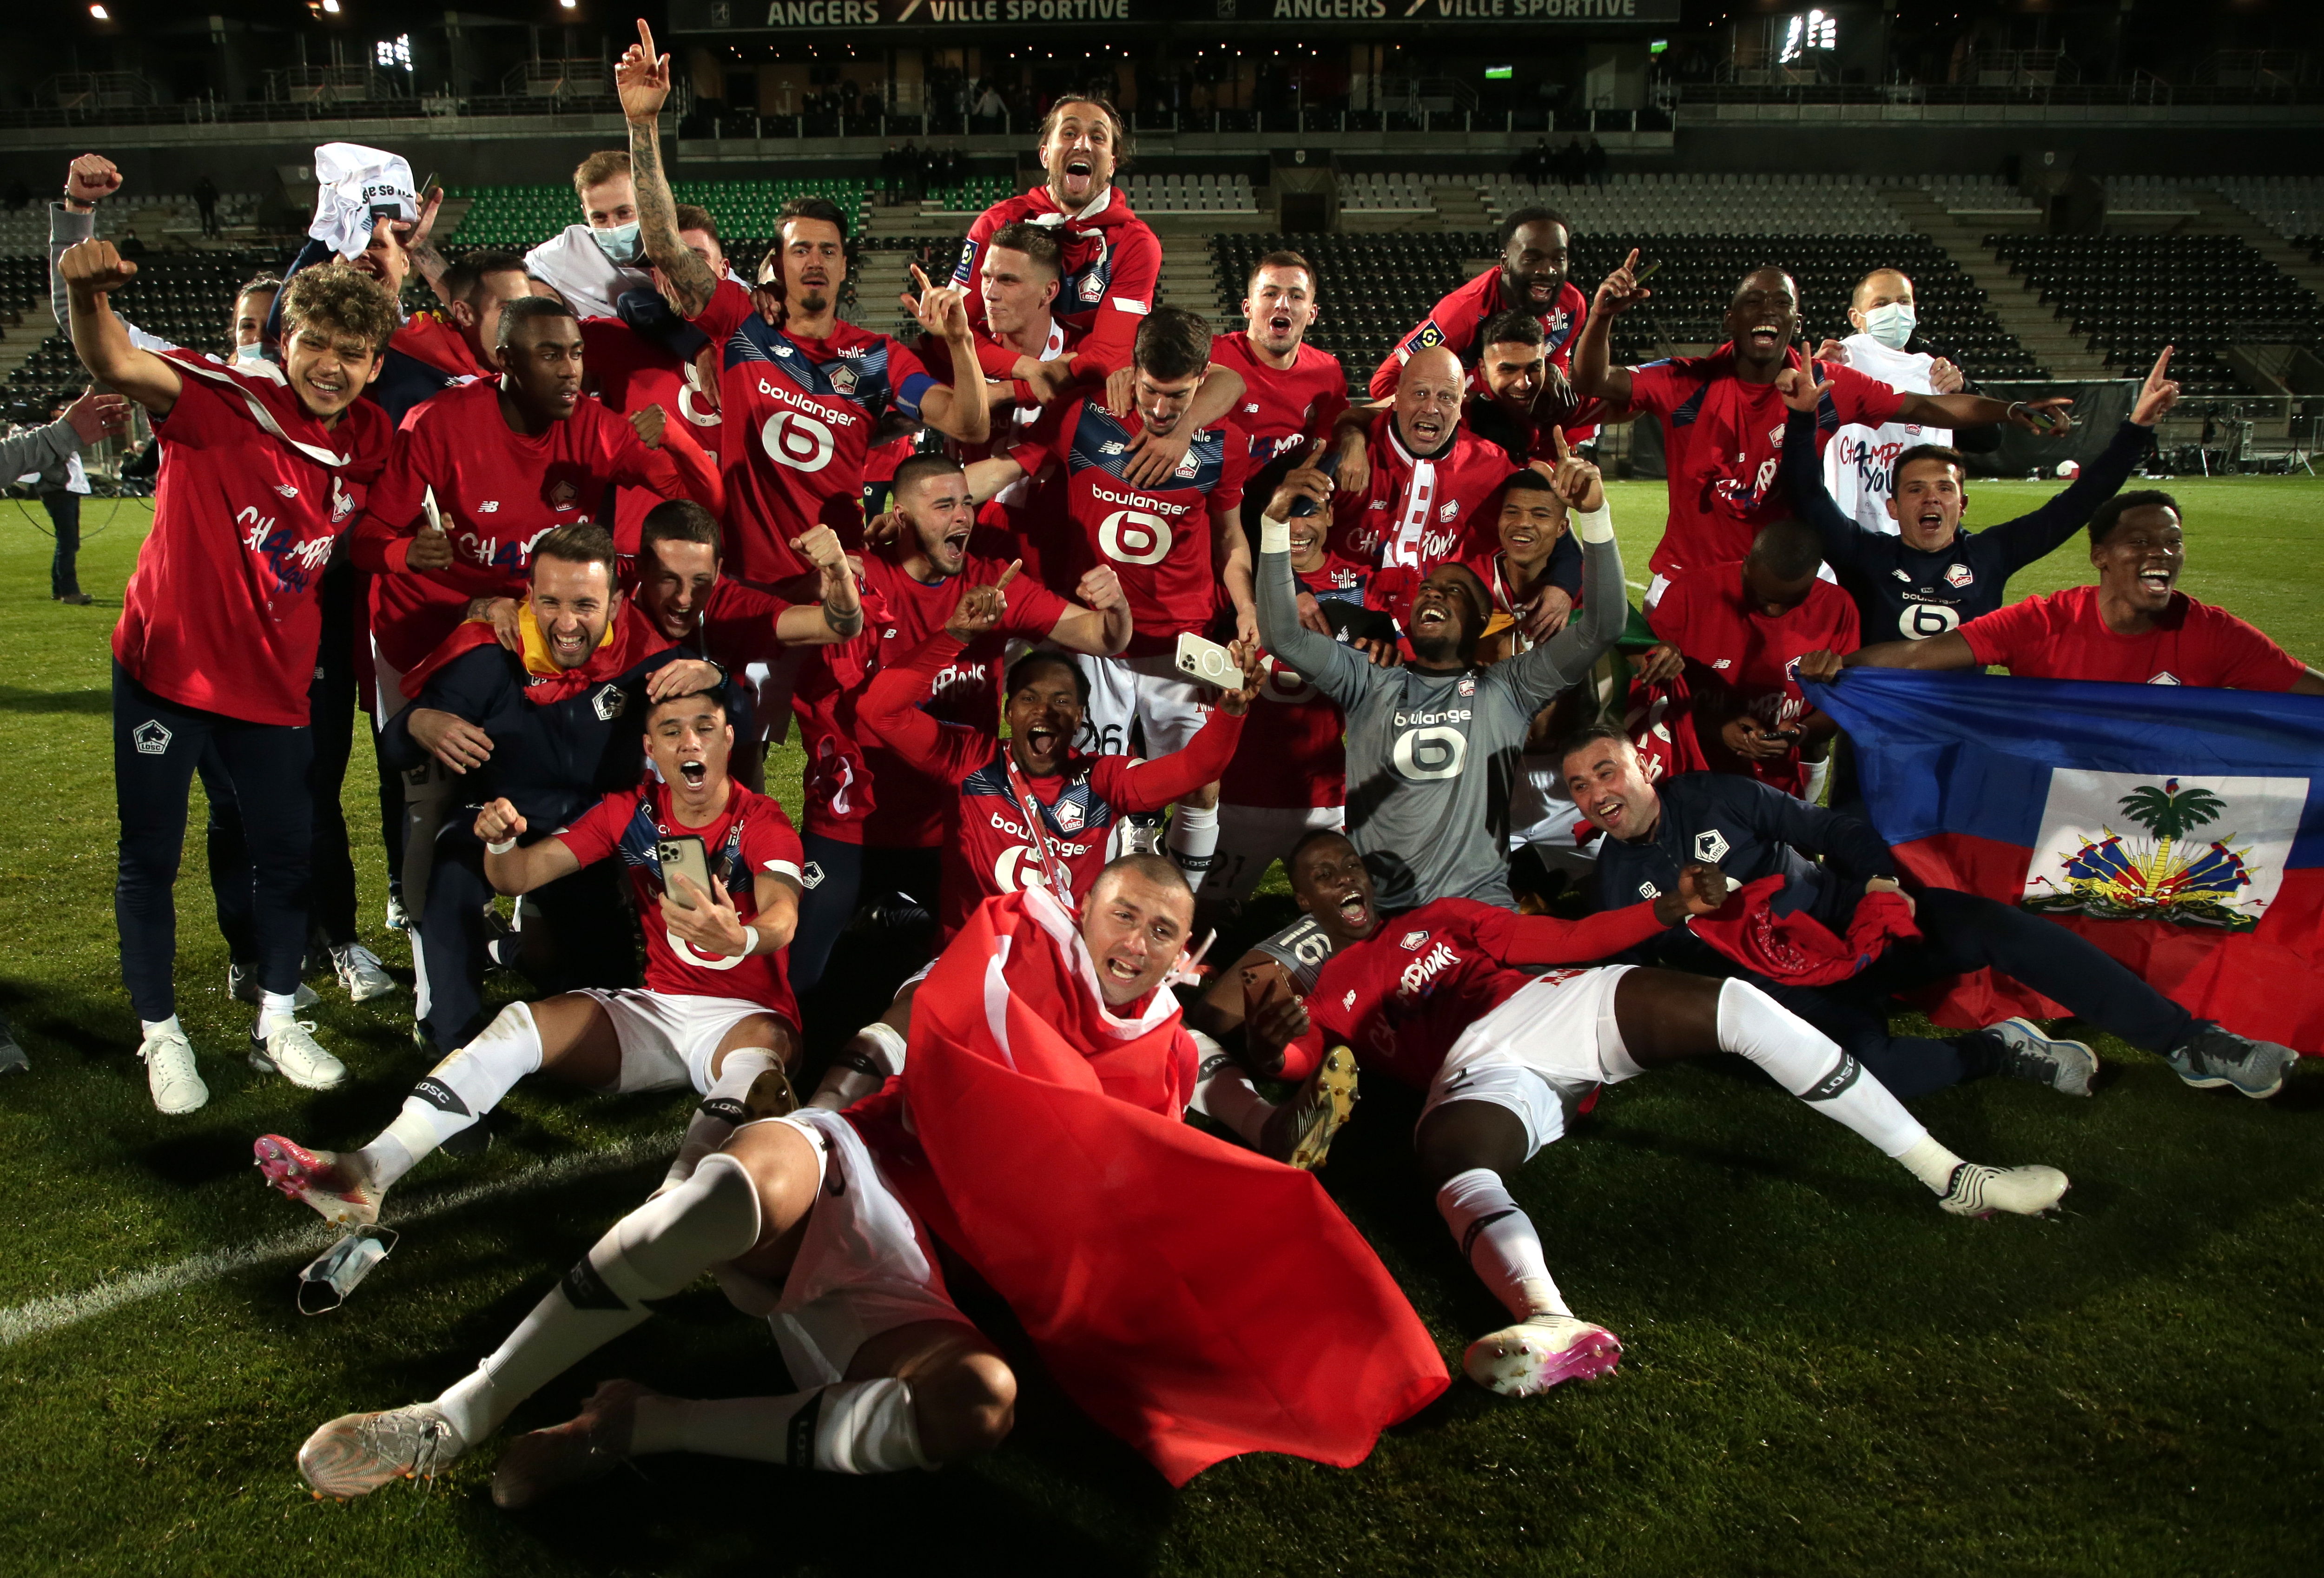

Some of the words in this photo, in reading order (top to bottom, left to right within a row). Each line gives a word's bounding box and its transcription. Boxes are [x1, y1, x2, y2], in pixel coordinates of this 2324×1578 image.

[768, 1, 879, 26] ANGERS
[930, 0, 997, 21] VILLE
[1006, 0, 1129, 20] SPORTIVE
[1274, 0, 1386, 18] ANGERS
[1439, 0, 1504, 17] VILLE
[1514, 0, 1635, 16] SPORTIVE
[379, 185, 394, 196] es
[759, 377, 856, 427] boulanger
[1092, 483, 1191, 515] boulanger
[1331, 568, 1357, 582] hello
[1954, 577, 1971, 587] LOSC
[990, 812, 1092, 857] bounger
[1064, 821, 1081, 830] LOSC
[1710, 845, 1724, 860] LOSC
[1182, 858, 1212, 867] LOSC
[1641, 884, 1653, 897] DP
[1279, 920, 1333, 966] 16
[1821, 1054, 1854, 1094] LOSC
[414, 1082, 450, 1104] LOSC
